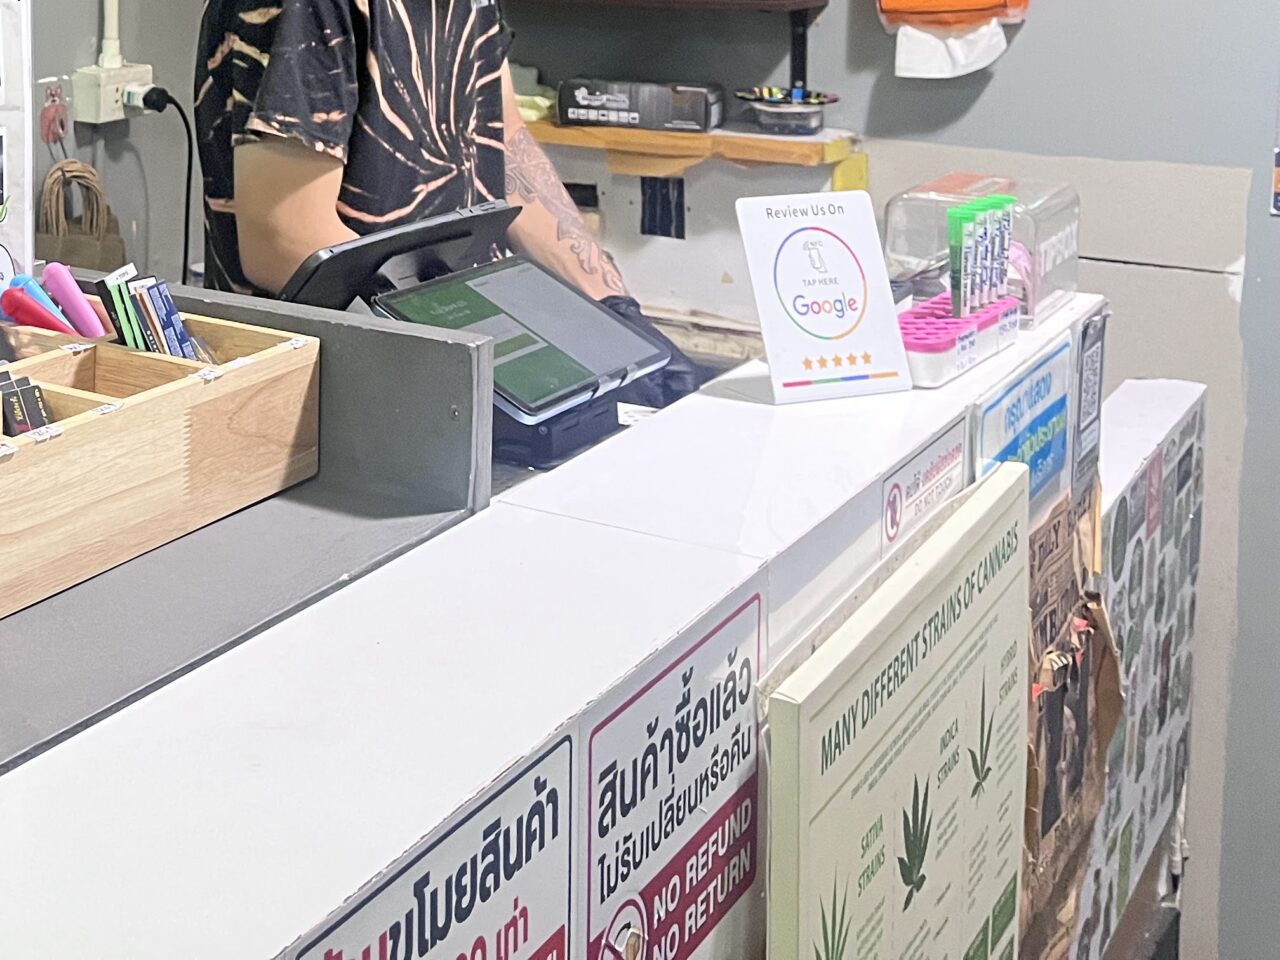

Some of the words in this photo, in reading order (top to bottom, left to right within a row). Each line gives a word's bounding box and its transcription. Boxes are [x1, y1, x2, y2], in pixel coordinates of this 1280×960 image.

[766, 205, 808, 219] Review
[811, 204, 825, 216] Us
[827, 203, 845, 215] On
[793, 292, 858, 319] Google
[802, 279, 816, 287] TAP
[819, 277, 839, 285] HERE
[821, 699, 859, 776] MANY
[861, 631, 920, 730] DIFFERENT
[922, 585, 962, 660] STRAINS
[963, 567, 976, 610] OF
[977, 521, 1019, 594] CANNABIS
[598, 647, 752, 839] สินค้าซื้อแล้ว
[939, 718, 959, 756] INDICA
[937, 744, 960, 789] STRAINS
[597, 721, 751, 906] ไม่รับเปลี่ยนหรือคืน
[861, 814, 884, 859] SATIVA
[653, 874, 679, 929] NO
[685, 798, 751, 887] REFUND
[858, 844, 885, 898] STRAINS
[653, 924, 679, 960] NO
[685, 843, 751, 943] RETURN
